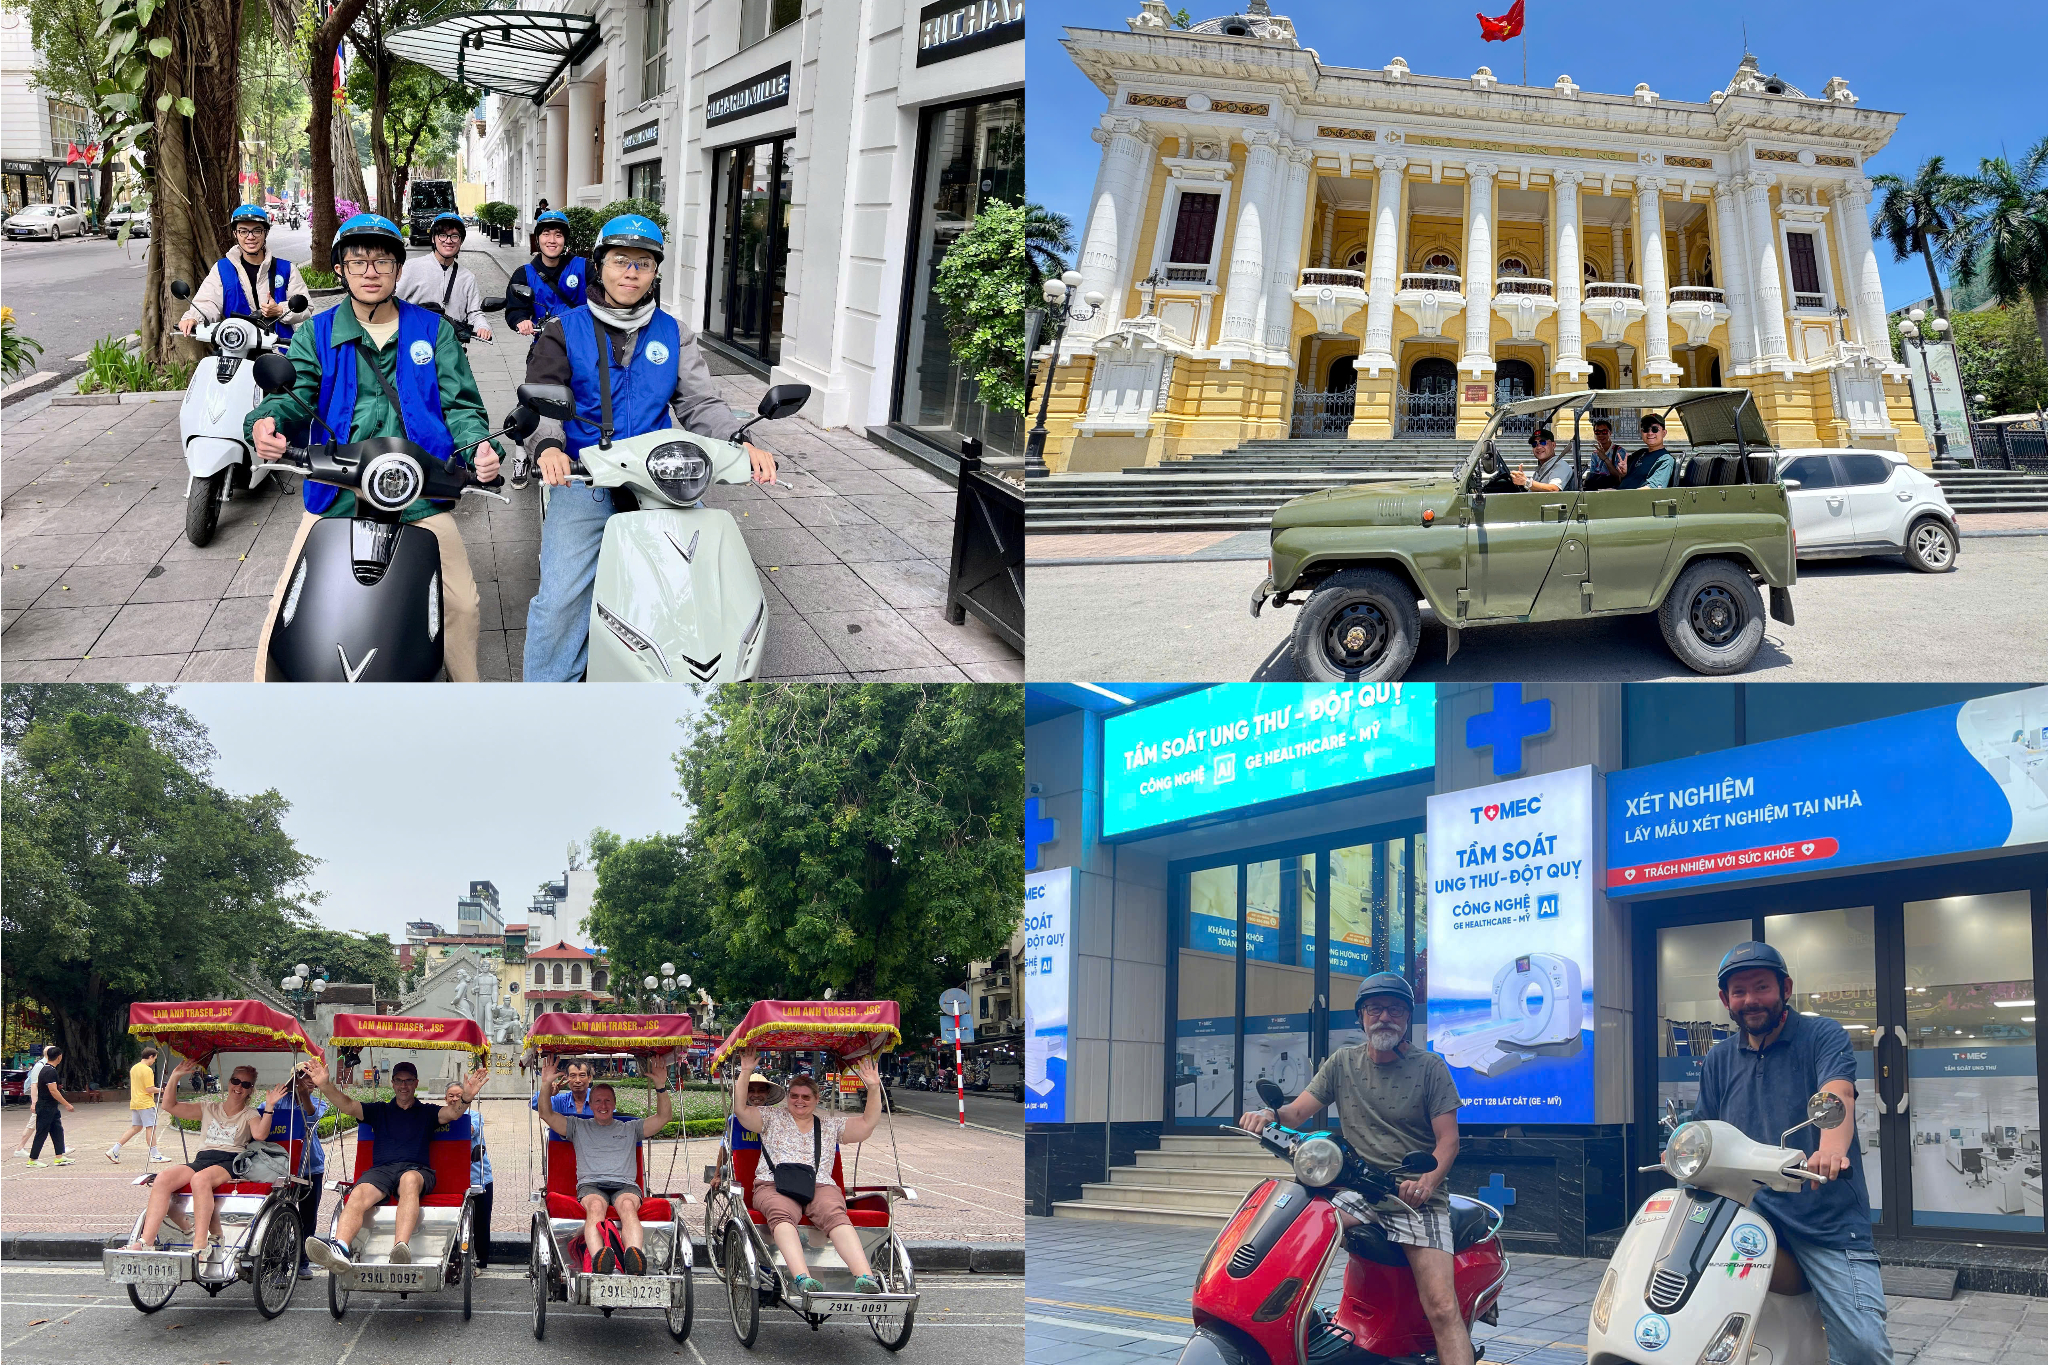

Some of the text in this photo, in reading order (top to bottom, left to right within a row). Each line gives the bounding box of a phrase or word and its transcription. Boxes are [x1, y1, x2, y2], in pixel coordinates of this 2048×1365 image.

[706, 74, 789, 120] RICHARD MILLE
[1124, 741, 1157, 771] TẦM
[1161, 729, 1207, 760] SOÁT
[1210, 719, 1249, 747] UNG
[1252, 705, 1292, 735] THƯ
[1309, 690, 1353, 722] ĐỘT
[1139, 776, 1172, 796] CÔNG
[1174, 765, 1205, 788] NGHỆ
[1217, 760, 1232, 779] AI
[1245, 756, 1263, 770] GE
[1264, 733, 1346, 765] HEALTHCARE
[1359, 721, 1381, 742] MỸ
[1626, 776, 1754, 817] XÉT NGHIỆM
[1625, 789, 1862, 843] LẤY MẪU XÉT NGHIỆM TẠI NHÀ
[1456, 832, 1557, 869] TẦM SOÁT
[1643, 845, 1795, 878] TRÁCH NHIỆM VỚI SỨC KHỎE
[1435, 877, 1466, 894] UNG
[1469, 870, 1500, 890] THƯ
[1509, 864, 1543, 887] ĐỘT
[1025, 885, 1046, 901] MEC
[1452, 893, 1555, 917] CÔNG NGHỆ AI
[1025, 912, 1053, 932] SOÁT
[1453, 922, 1464, 930] GE
[1465, 917, 1512, 929] HEALTHCARE
[1518, 912, 1531, 923] MỸ
[1207, 925, 1229, 937] KHÁM
[1027, 934, 1045, 950] ĐỘT
[1217, 936, 1237, 948] TOÀN
[1025, 955, 1051, 971] GHỆ AI
[1340, 959, 1348, 967] 3.0
[153, 1009, 168, 1019] LAM
[170, 1008, 184, 1018] ANH
[782, 1007, 800, 1016] LAM
[802, 1007, 821, 1016] ANH
[864, 1004, 880, 1015] JSC
[358, 1020, 375, 1030] LAM
[377, 1021, 393, 1031] ANH
[572, 1021, 588, 1031] LAM
[590, 1021, 607, 1031] ANH
[1461, 1098, 1472, 1107] ỤP
[1473, 1098, 1483, 1106] CT
[1484, 1097, 1497, 1106] 128
[1498, 1096, 1511, 1106] LÁT
[1528, 1097, 1541, 1107] (GE
[741, 1130, 759, 1142] LAM
[390, 1273, 417, 1284] 0092
